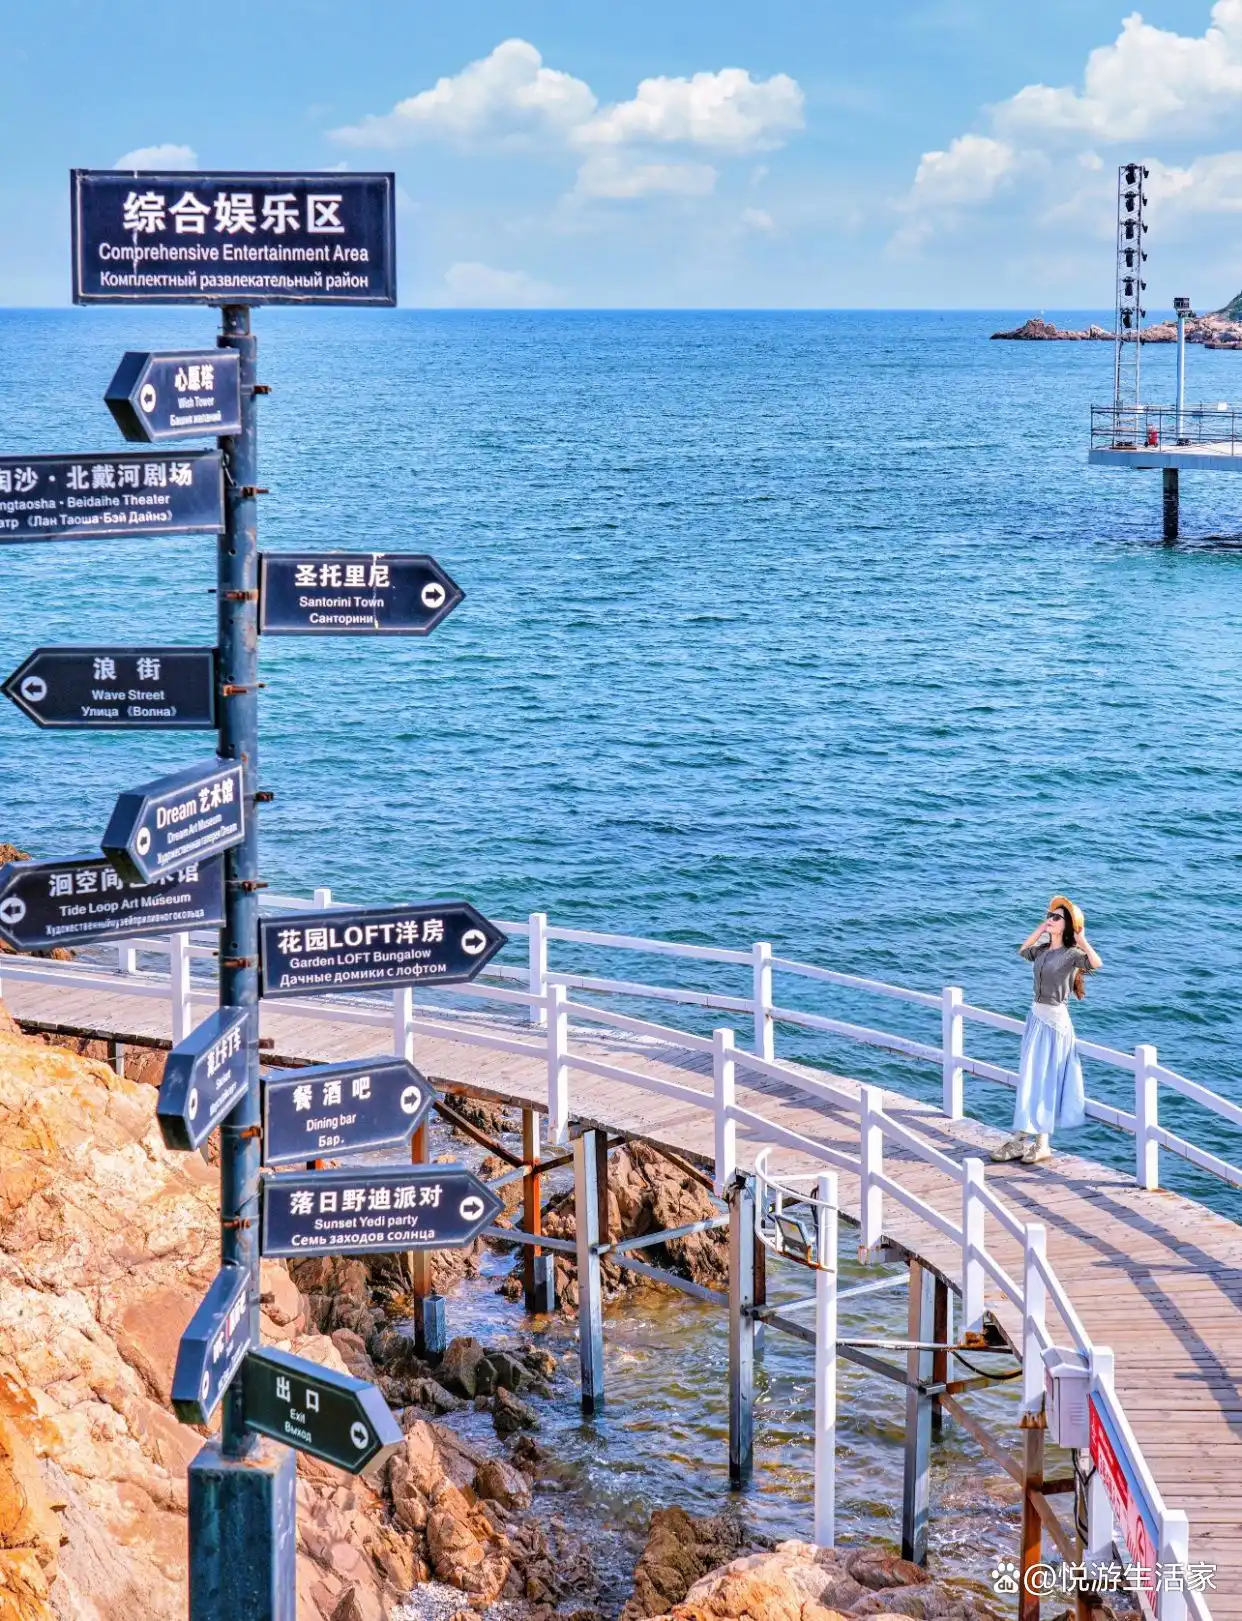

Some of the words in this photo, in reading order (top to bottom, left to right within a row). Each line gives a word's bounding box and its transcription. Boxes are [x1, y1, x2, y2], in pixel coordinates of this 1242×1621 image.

[122, 192, 345, 234] 综合娱乐区
[99, 243, 219, 264] Comprehensive
[223, 243, 329, 262] Entertainment
[333, 244, 369, 262] Area
[100, 271, 196, 287] Комплектный
[200, 271, 323, 290] развлекательный
[326, 273, 368, 289] район
[174, 364, 214, 392] 心愿塔
[67, 495, 120, 509] Beidaihe
[122, 494, 170, 506] Theater
[294, 564, 390, 587] 圣托里尼
[299, 596, 352, 608] Santorini
[354, 597, 384, 608] Town
[309, 612, 373, 625] Санторини
[91, 689, 126, 700] Wave
[128, 689, 165, 700] Street
[156, 799, 197, 829] Dream
[198, 778, 234, 813] 艺术馆
[59, 905, 87, 917] Tide
[89, 901, 119, 915] Loop
[121, 899, 139, 910] Art
[141, 893, 191, 908] Museum
[277, 919, 444, 954] 花园LOFT洋房
[289, 957, 334, 970] Garden
[337, 952, 370, 965] LOFT
[373, 948, 432, 964] Bungalow
[279, 972, 332, 988] Дачные
[334, 968, 385, 984] домики
[396, 962, 447, 978] лофтом
[306, 1117, 338, 1132] Dining
[340, 1113, 357, 1125] bar
[290, 1184, 443, 1215] 落日野迪派对
[314, 1218, 357, 1230] Sunset
[359, 1216, 385, 1228] Yedi
[388, 1214, 418, 1227] party
[291, 1234, 327, 1246] Семь
[329, 1231, 384, 1245] заходов
[388, 1229, 435, 1242] солнца
[276, 1376, 319, 1413] 出口
[290, 1408, 306, 1424] Exit
[284, 1420, 312, 1443] Выход
